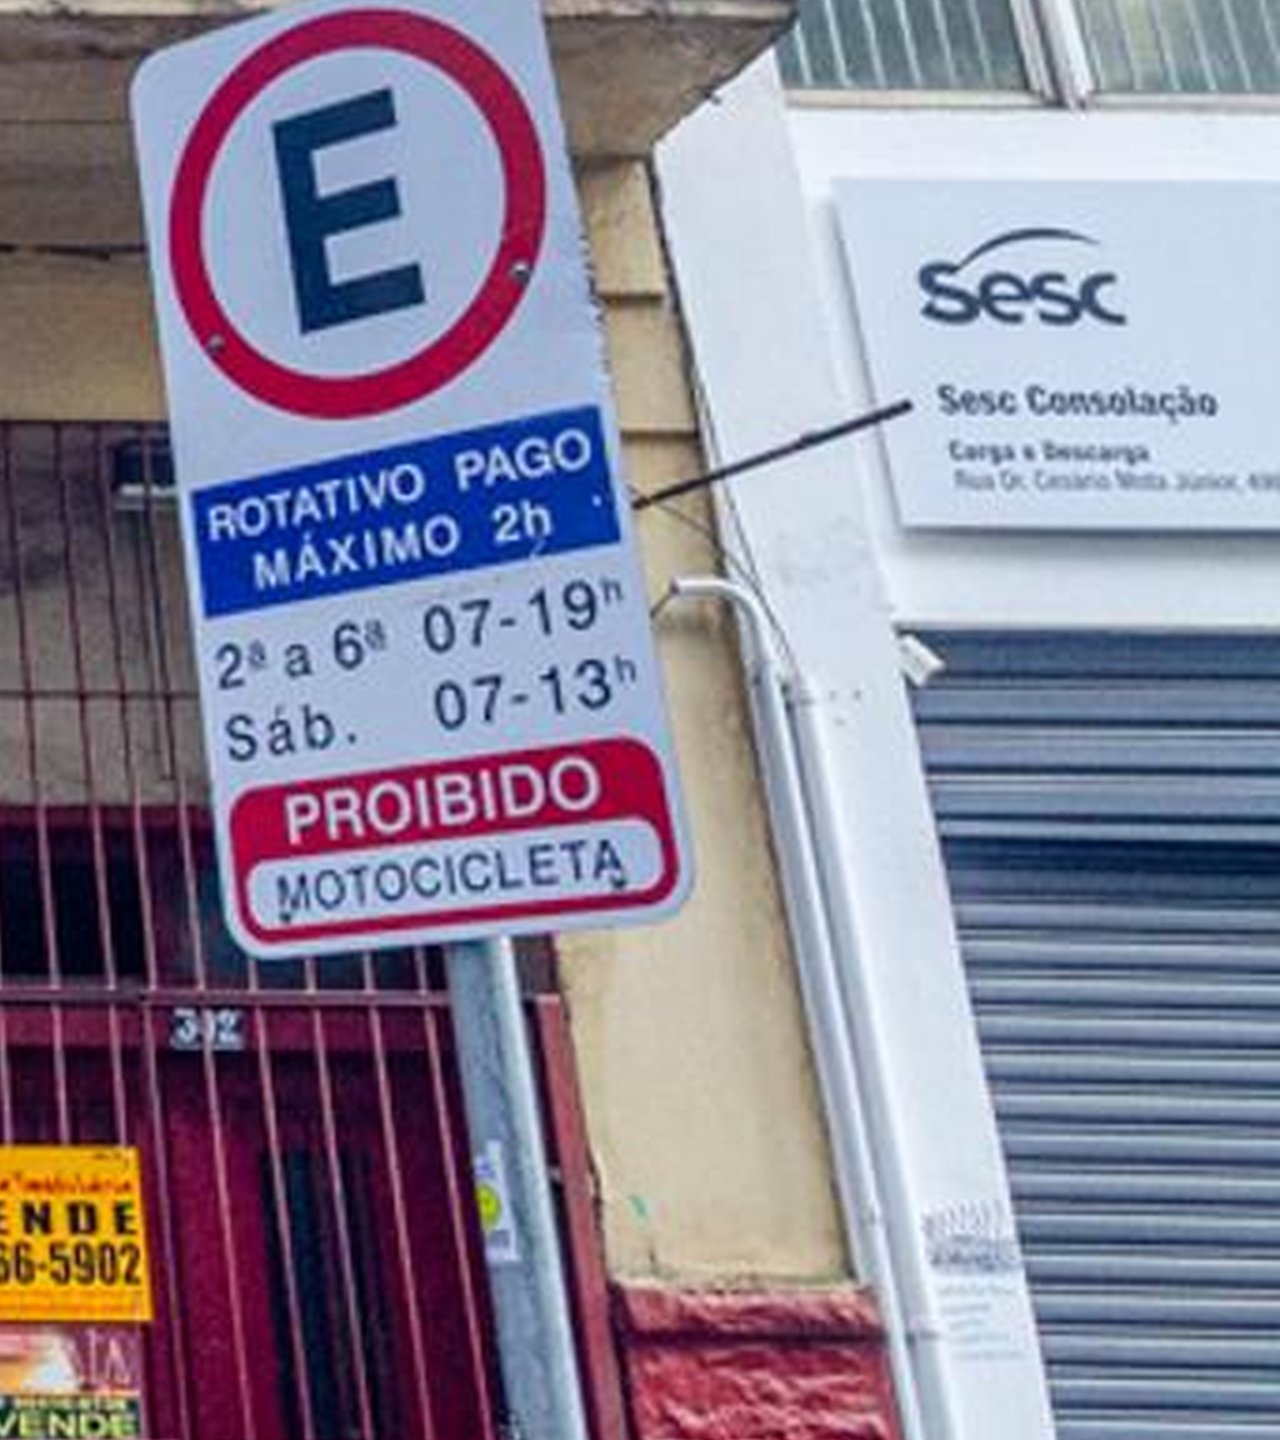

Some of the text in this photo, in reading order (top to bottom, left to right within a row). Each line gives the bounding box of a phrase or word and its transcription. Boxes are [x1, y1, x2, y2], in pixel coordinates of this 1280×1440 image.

[272, 87, 426, 335] E
[938, 384, 1219, 425] Sesc Consolação
[208, 429, 592, 541] ROTATIVO PAGO
[948, 440, 1015, 465] Carga
[1043, 441, 1151, 465] Descarga
[253, 501, 552, 589] MÁXIMO 2h
[283, 642, 313, 678] a
[224, 702, 357, 762] Sáb.
[283, 756, 602, 845] PROIBIDO
[276, 839, 625, 914] MOTOCICLETA
